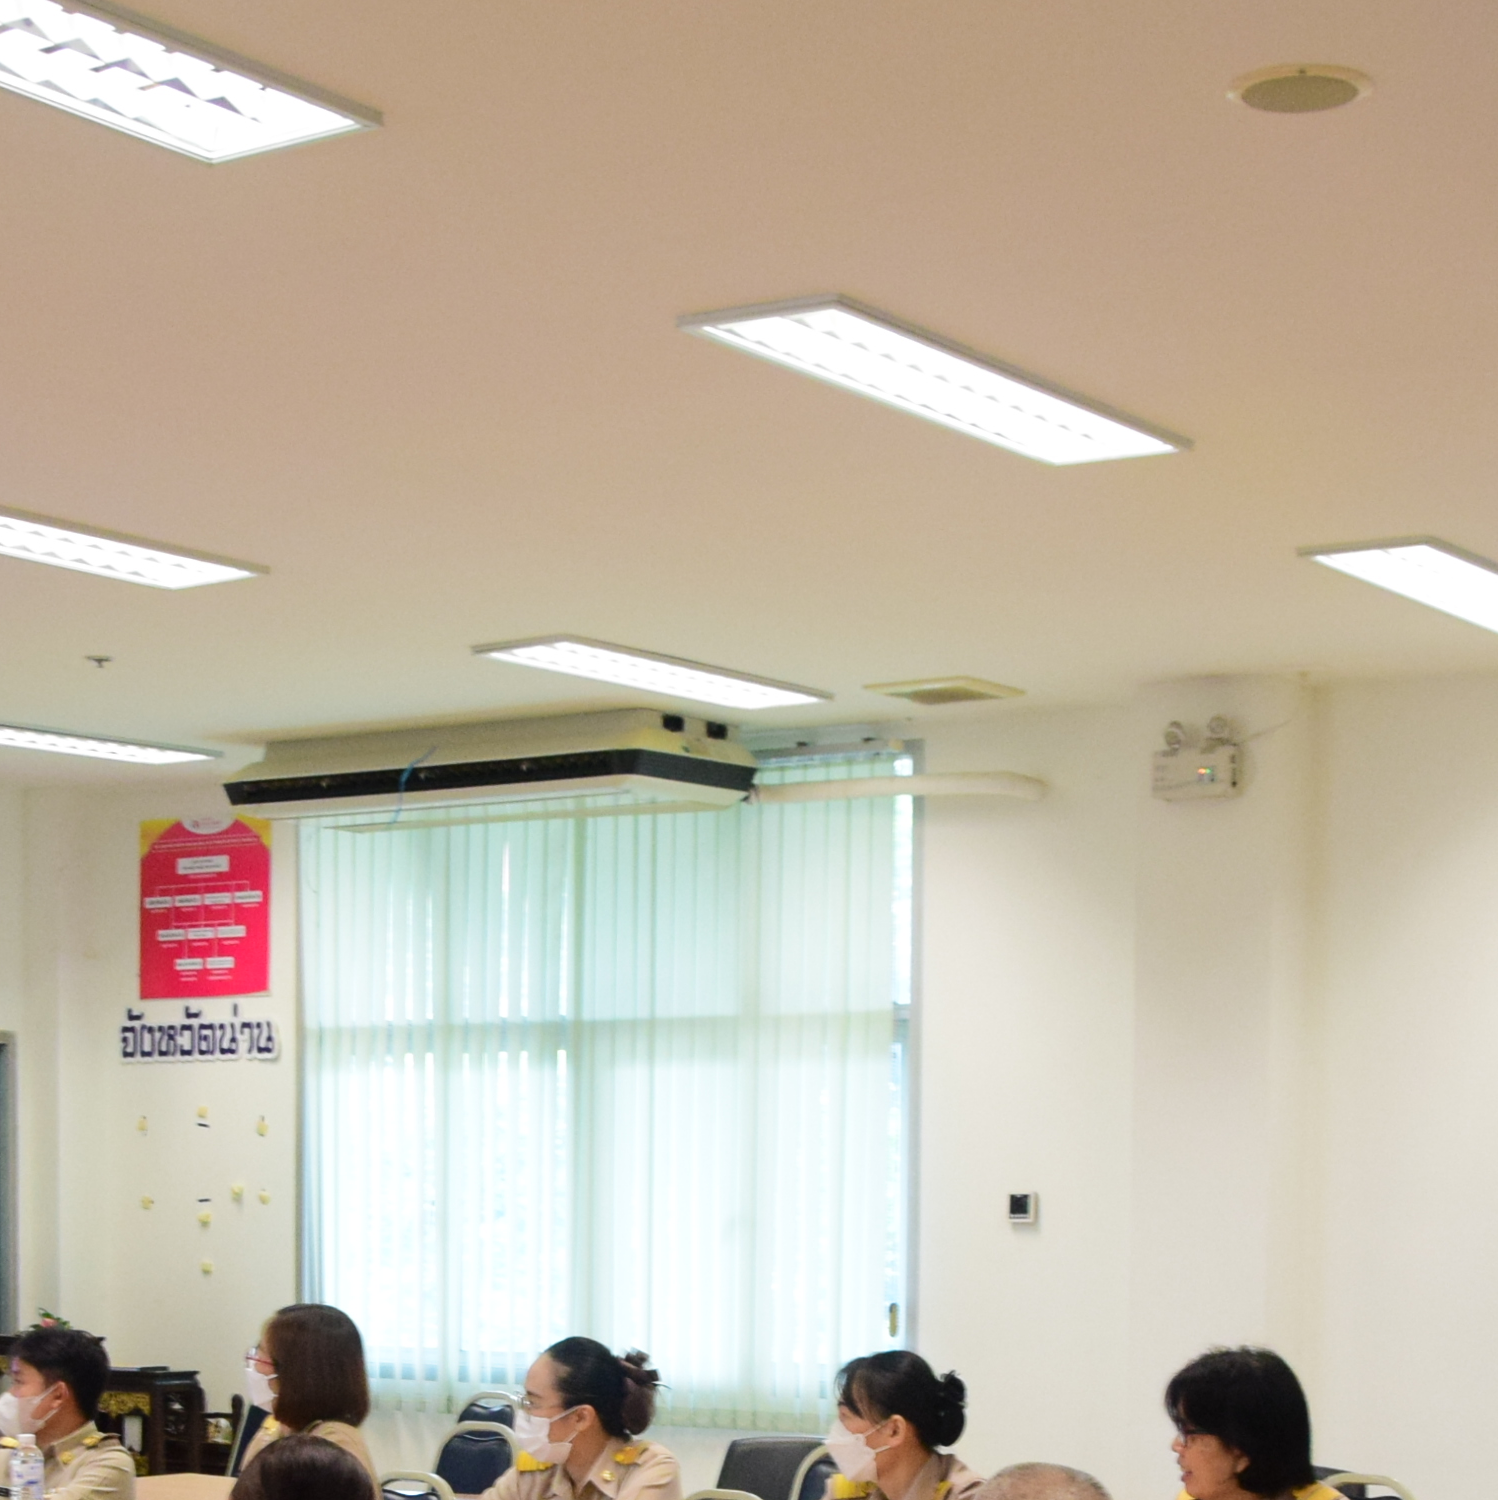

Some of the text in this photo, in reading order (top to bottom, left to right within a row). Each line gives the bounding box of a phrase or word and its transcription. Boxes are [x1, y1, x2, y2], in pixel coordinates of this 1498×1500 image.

[121, 1003, 275, 1059] จังหวัดน่าน
